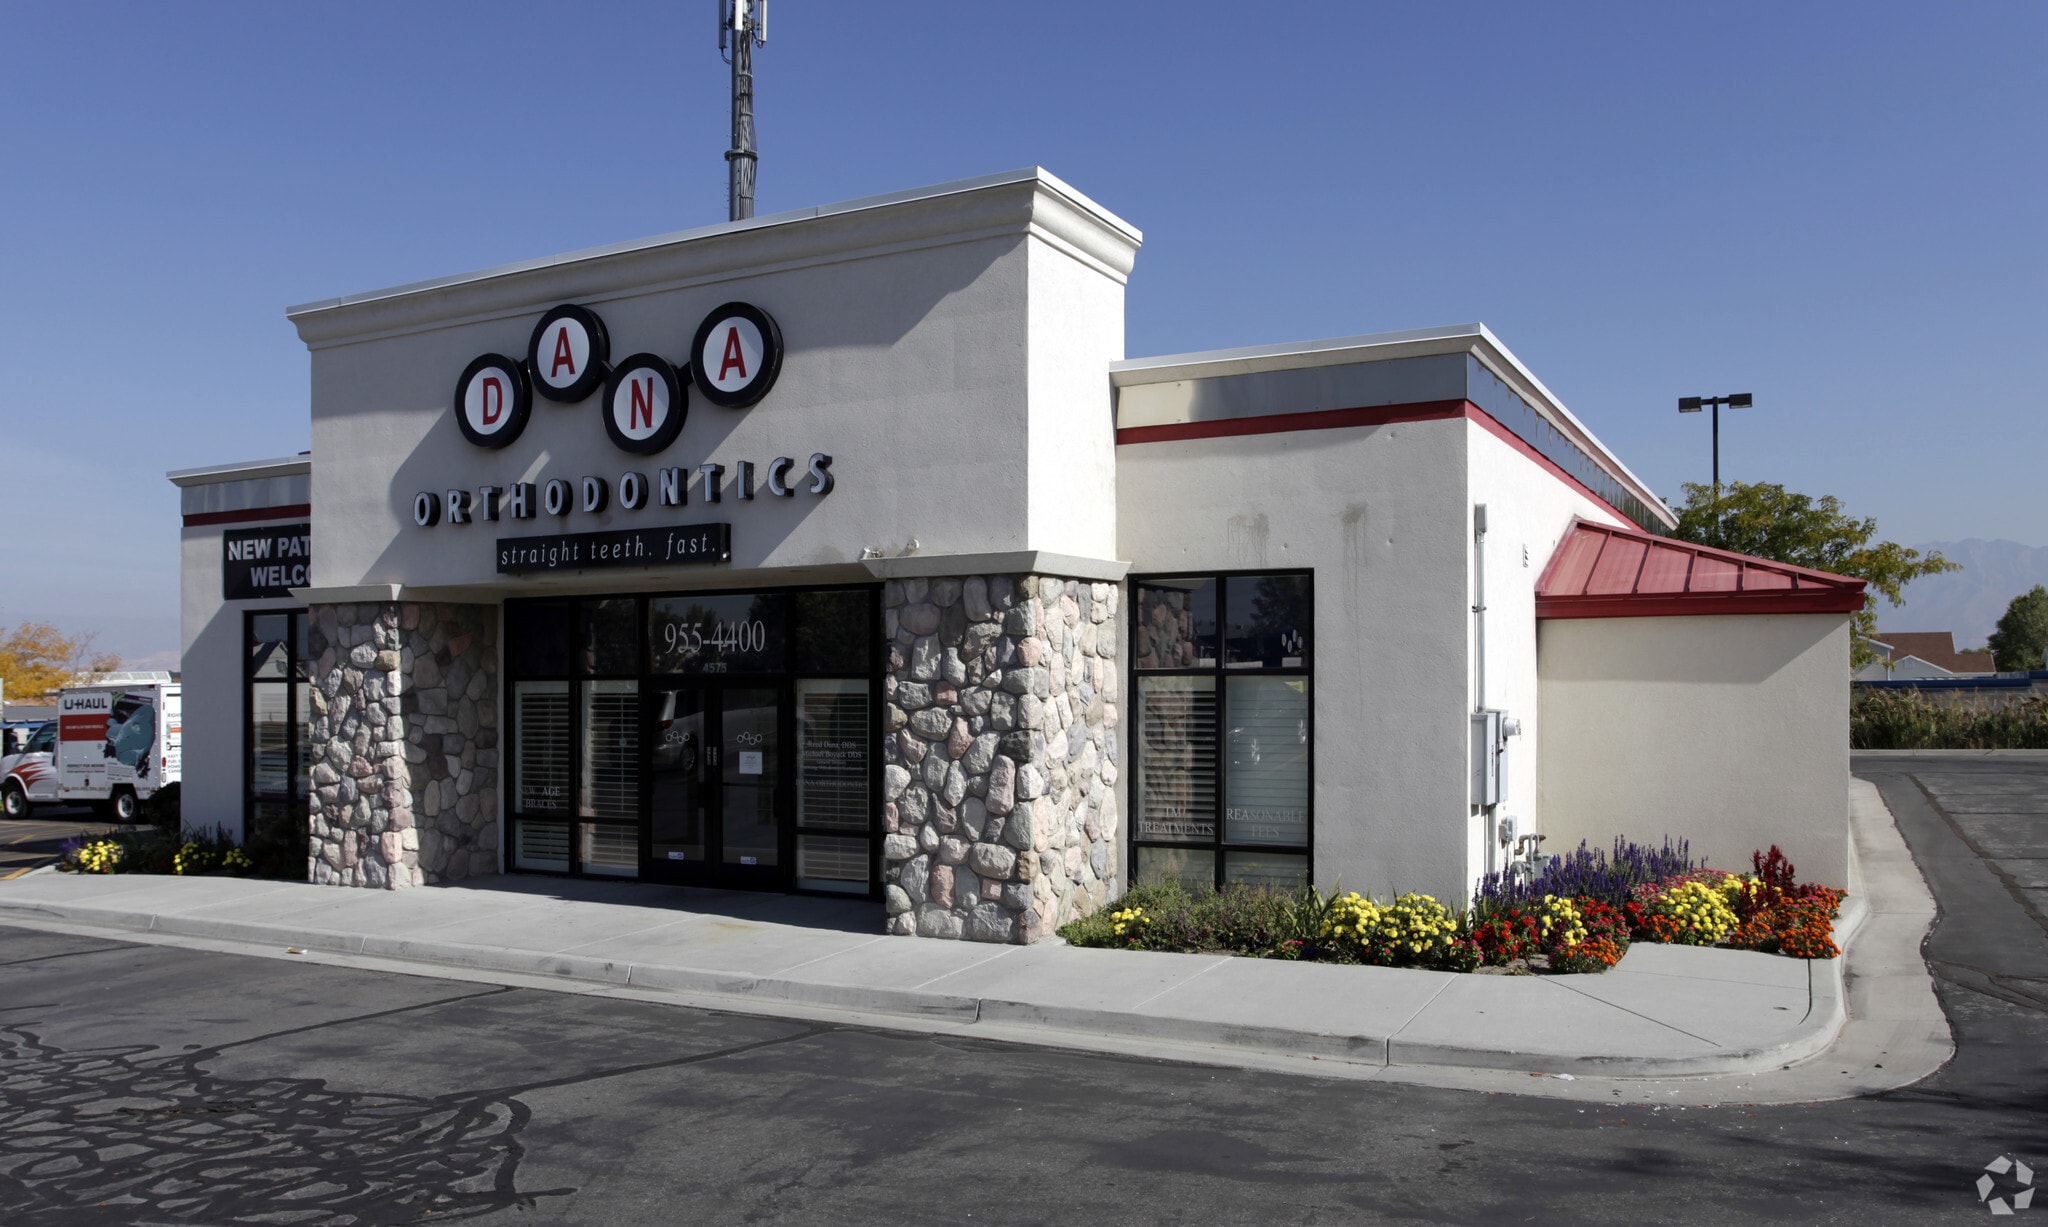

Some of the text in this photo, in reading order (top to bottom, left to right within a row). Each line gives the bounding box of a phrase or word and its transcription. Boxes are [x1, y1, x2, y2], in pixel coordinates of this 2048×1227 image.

[414, 453, 834, 526] ORTHODONTICS
[228, 538, 272, 560] NEW
[501, 532, 716, 567] straight teeth. fast.
[664, 620, 765, 654] 955-4400
[702, 662, 727, 673] 4575
[64, 697, 108, 710] U-HAUL
[841, 741, 857, 749] DDS
[541, 786, 561, 796] AGE
[525, 798, 557, 809] BRACES
[1226, 807, 1304, 824] REASONABLE
[1138, 821, 1216, 835] TREATMENTS
[1251, 825, 1280, 838] FEES
